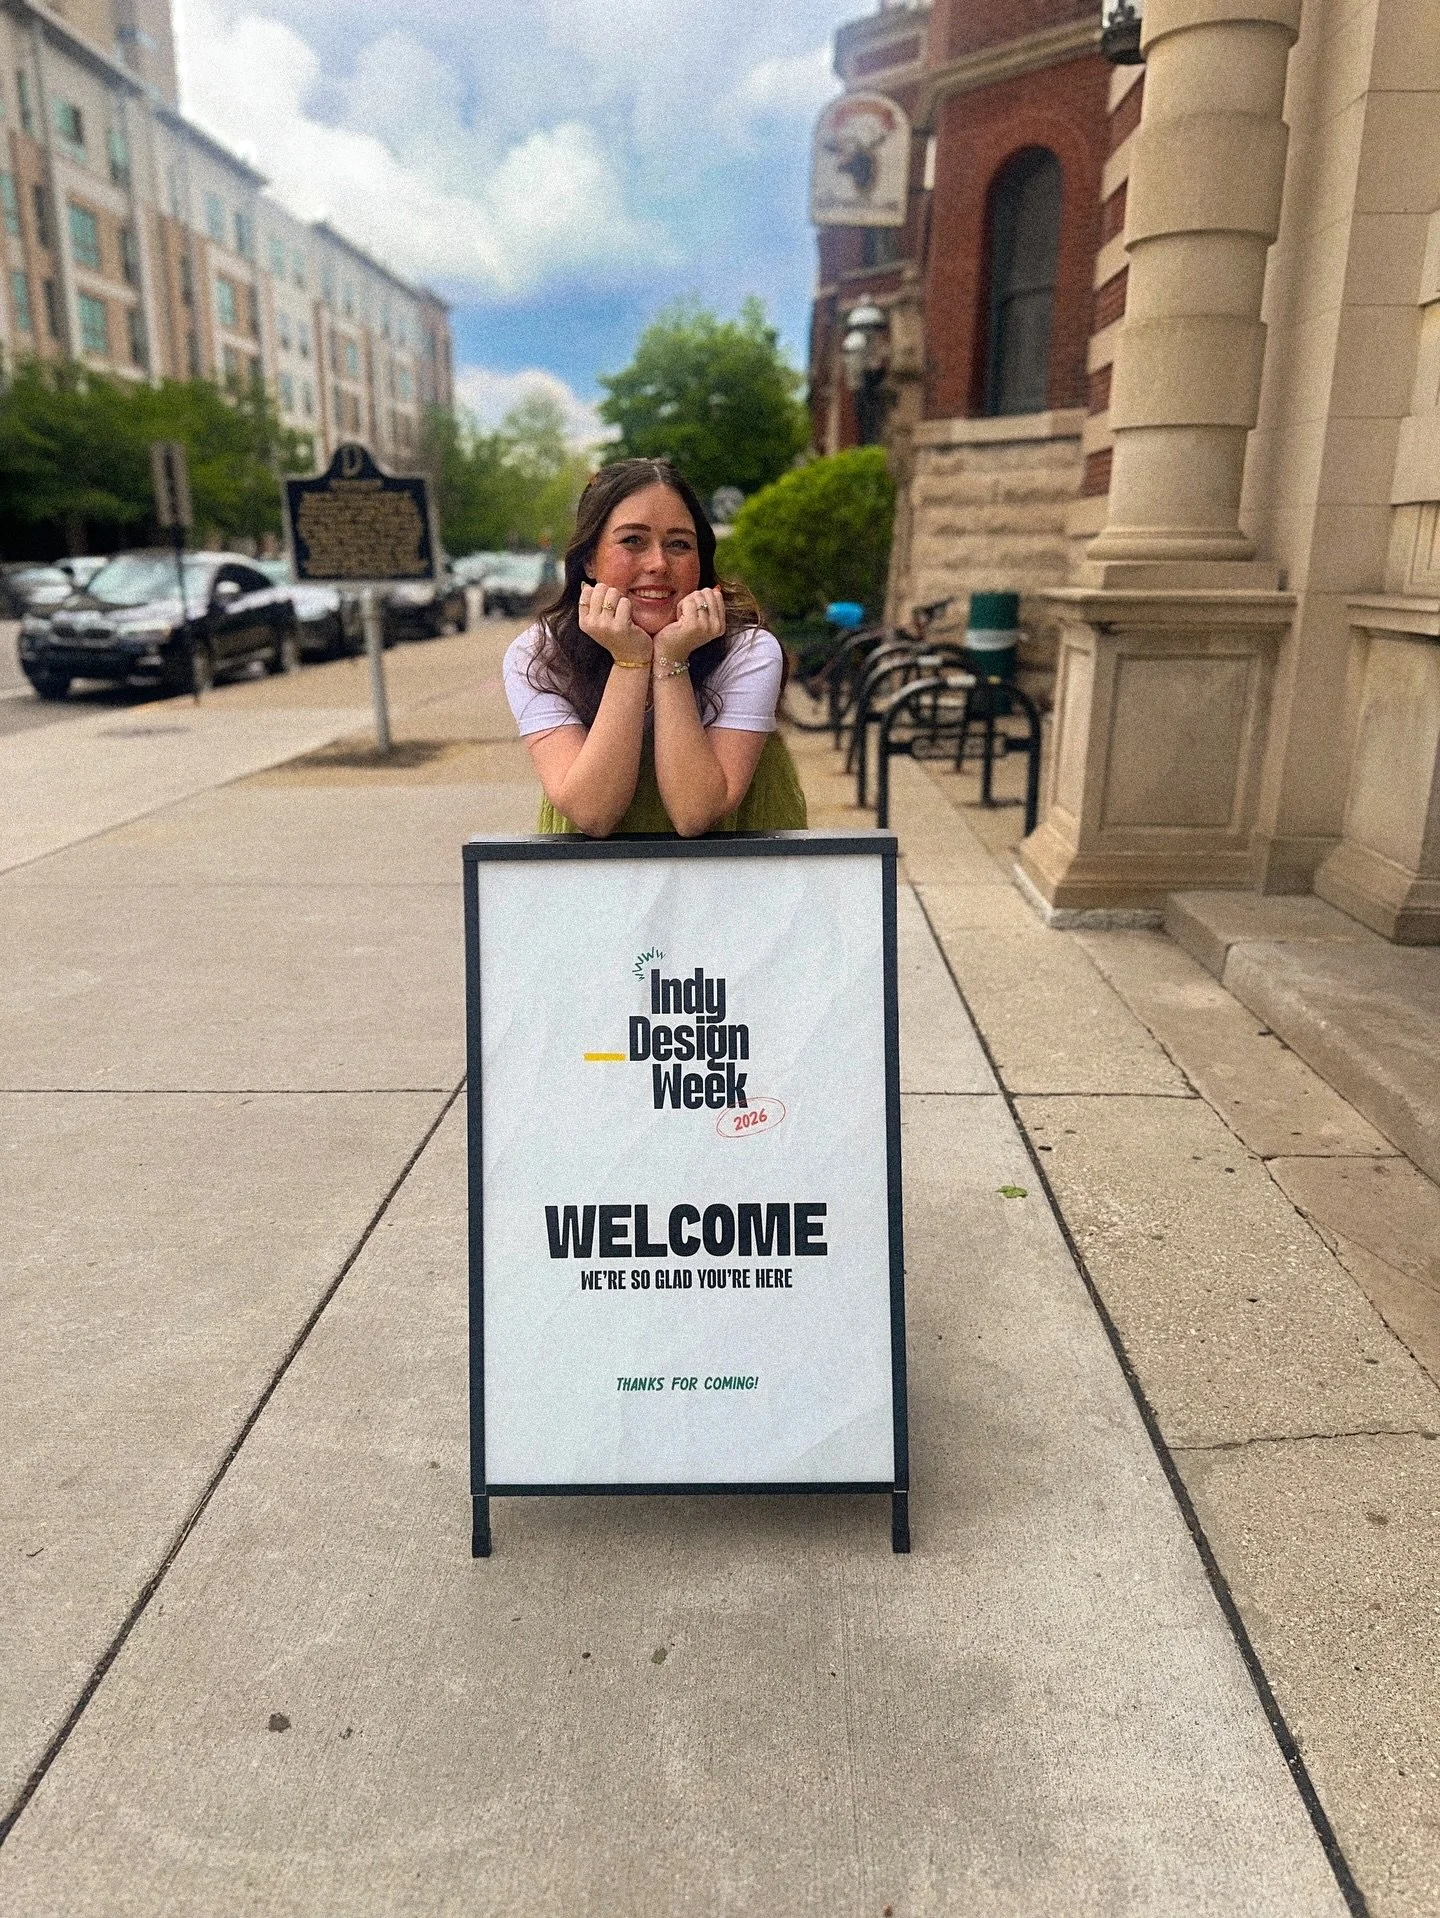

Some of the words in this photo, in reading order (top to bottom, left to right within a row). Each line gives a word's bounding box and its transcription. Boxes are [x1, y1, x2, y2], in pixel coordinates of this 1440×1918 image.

[651, 967, 726, 1024] Indy
[629, 1015, 750, 1072] Design
[652, 1063, 749, 1110] Week
[733, 1108, 768, 1131] 2026
[545, 1203, 828, 1259] WELCOME
[581, 1270, 627, 1290] WE'RE
[631, 1269, 651, 1290] SO
[655, 1269, 693, 1289] GLAD
[697, 1268, 751, 1289] YOU'RE
[755, 1268, 793, 1289] HERE
[616, 1377, 665, 1391] THANKS
[671, 1376, 698, 1391] FOR
[704, 1376, 759, 1390] COMING!
